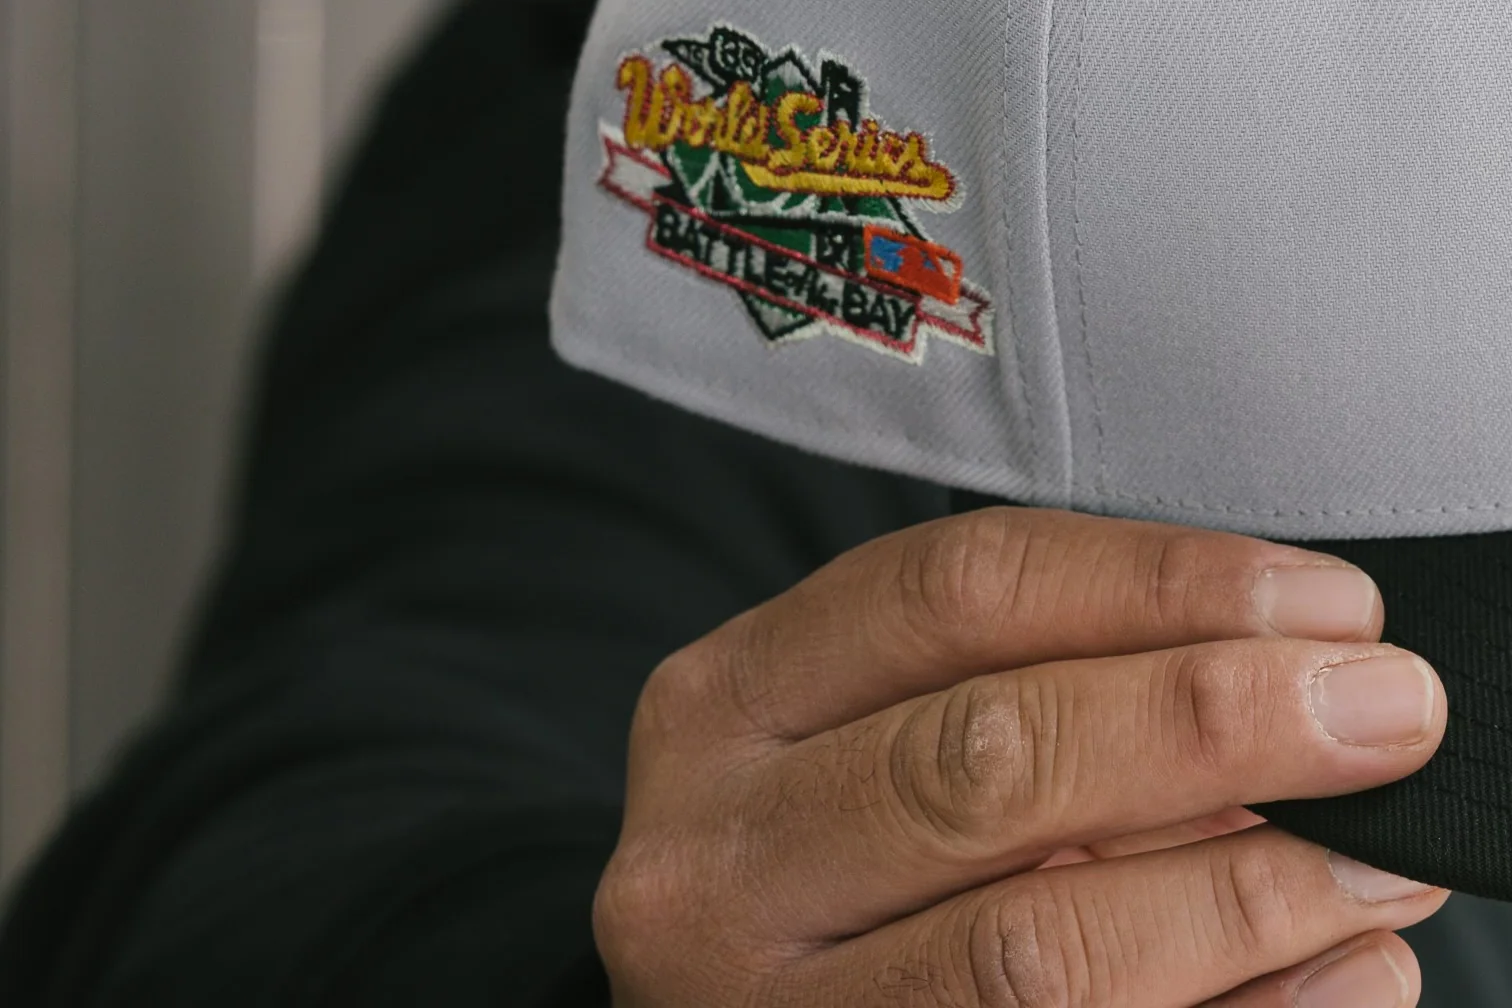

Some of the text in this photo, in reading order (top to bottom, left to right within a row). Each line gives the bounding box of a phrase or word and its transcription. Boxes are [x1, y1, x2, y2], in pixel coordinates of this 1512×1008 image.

[617, 56, 770, 162] World
[758, 90, 957, 199] Series
[655, 202, 790, 296] BATTLE
[843, 278, 916, 340] BAY
